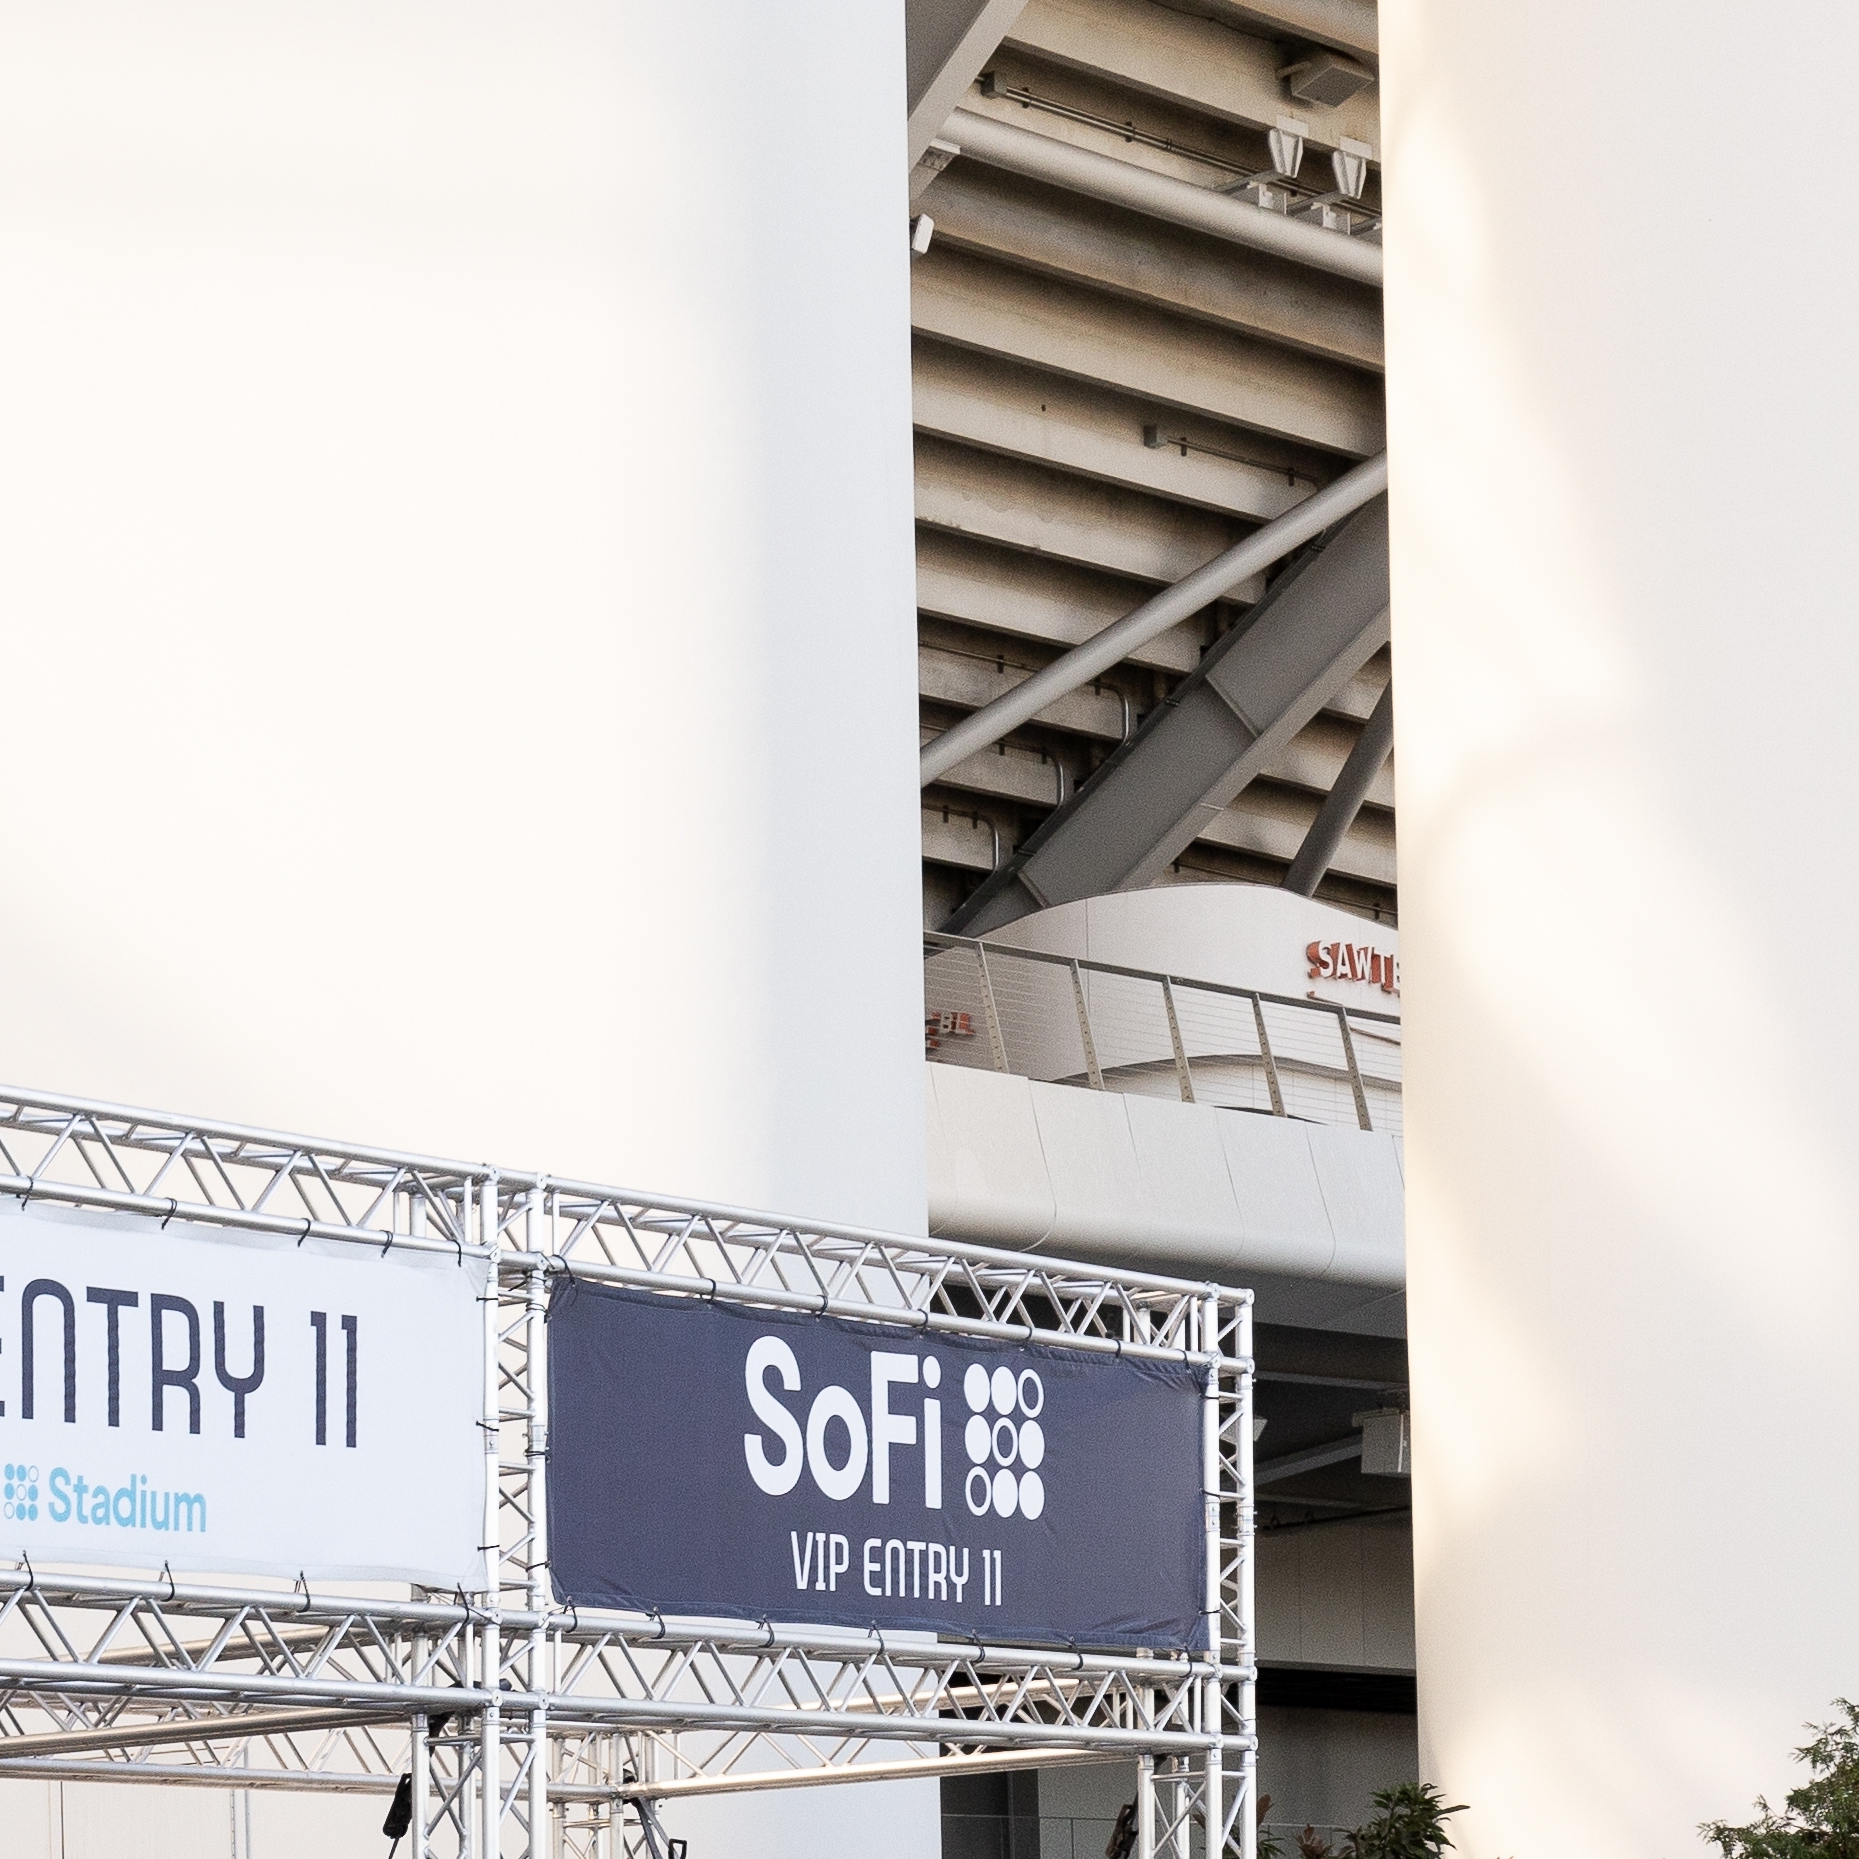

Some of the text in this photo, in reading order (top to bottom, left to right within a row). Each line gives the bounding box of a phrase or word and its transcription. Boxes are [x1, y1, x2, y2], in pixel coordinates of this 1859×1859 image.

[310, 1311, 358, 1449] 11
[744, 1336, 943, 1509] SoFi
[48, 1467, 207, 1532] Stadium
[791, 1531, 1001, 1605] VIP ENTRY 11
